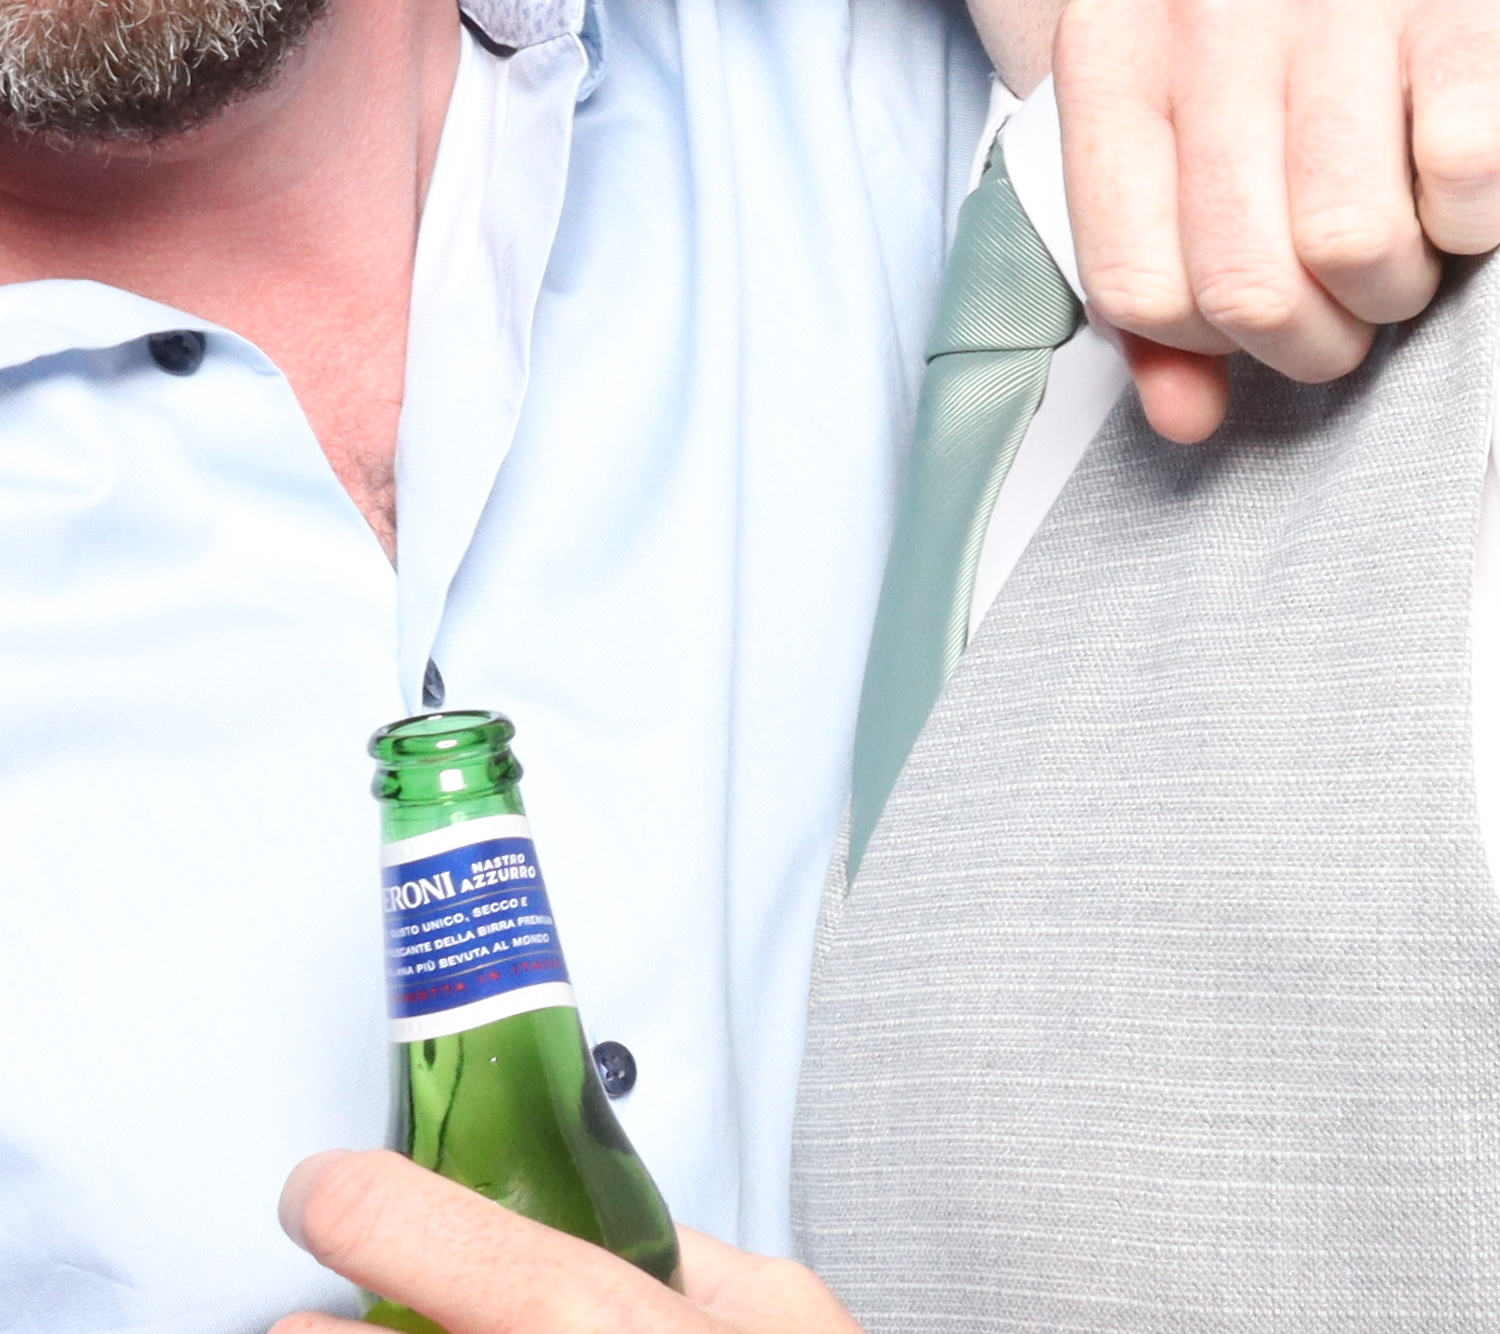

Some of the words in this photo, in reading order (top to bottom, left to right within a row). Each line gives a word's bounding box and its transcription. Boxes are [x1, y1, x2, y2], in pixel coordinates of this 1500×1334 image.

[461, 865, 537, 894] AZZURRO
[471, 853, 526, 874] NASTRO
[422, 912, 471, 933] UNICO,
[472, 898, 519, 919] SECCO
[520, 896, 529, 908] E
[434, 930, 476, 951] DELLA
[477, 917, 516, 937] BIRRA
[416, 959, 436, 975] PIÙ
[439, 946, 491, 970] BEVUTA
[493, 940, 510, 953] AL
[512, 933, 550, 949] MONDO
